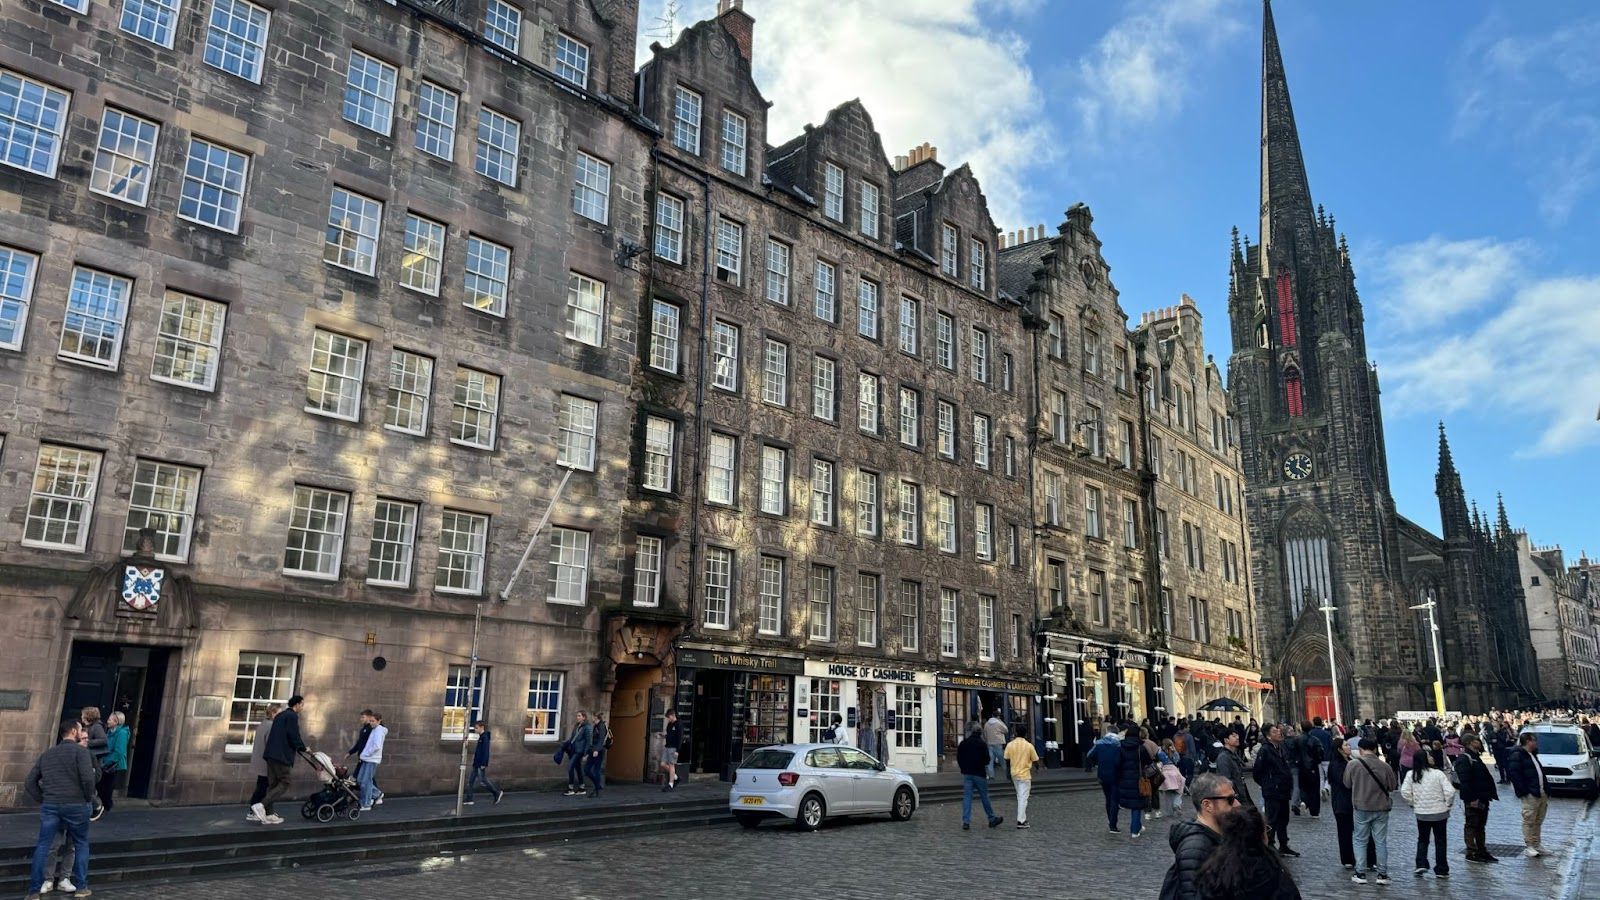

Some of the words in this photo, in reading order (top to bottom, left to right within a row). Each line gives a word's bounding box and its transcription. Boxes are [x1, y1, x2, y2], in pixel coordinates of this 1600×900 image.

[713, 654, 728, 665] The
[730, 655, 759, 669] Whisky
[760, 657, 777, 668] Trail
[1101, 659, 1107, 667] K
[828, 664, 858, 677] HOUSE
[860, 667, 870, 678] OF
[872, 668, 916, 682] CASHMERE
[952, 677, 981, 687] EDINBURGH
[981, 679, 1006, 689] CASHMERE
